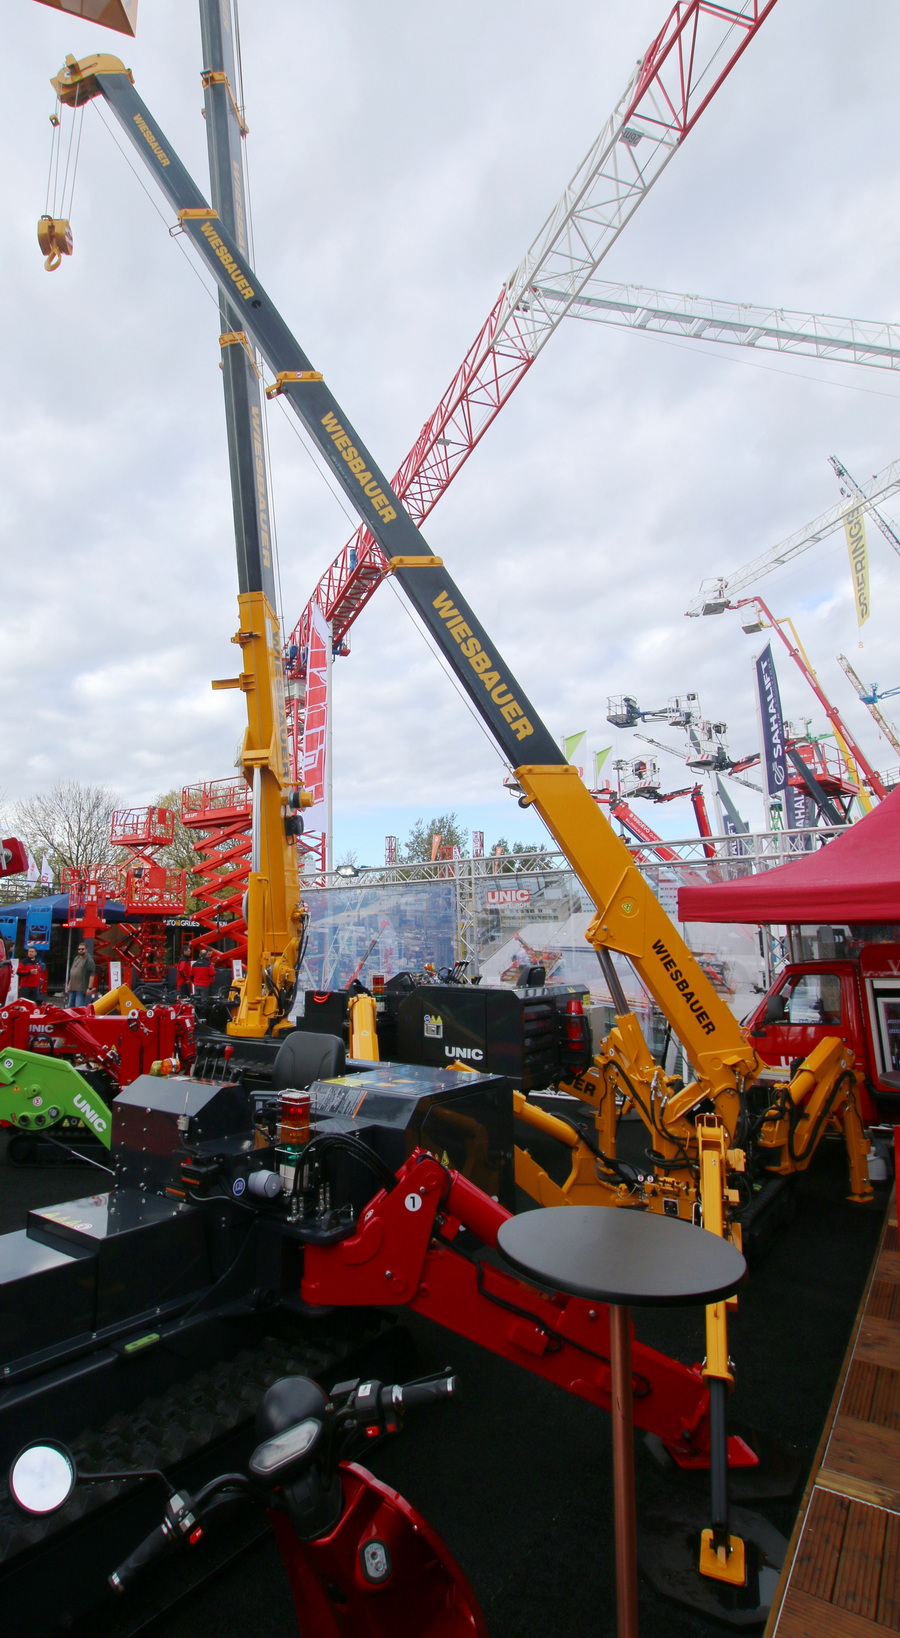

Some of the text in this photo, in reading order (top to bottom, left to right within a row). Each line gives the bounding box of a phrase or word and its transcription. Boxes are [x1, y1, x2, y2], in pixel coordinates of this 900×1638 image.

[132, 113, 171, 167] WIESBAUER
[200, 221, 255, 300] WIESBAUER
[251, 406, 271, 569] WIESBAUER
[320, 411, 397, 524] WIESBAUER
[272, 631, 289, 778] WIESBAUER
[432, 590, 534, 741] WIESBAUER
[761, 660, 783, 759] SAHALIFT
[487, 889, 529, 903] UNIC
[651, 938, 716, 1036] WIESBAUER
[444, 1046, 484, 1061] UNIC
[73, 1093, 107, 1133] UNIC
